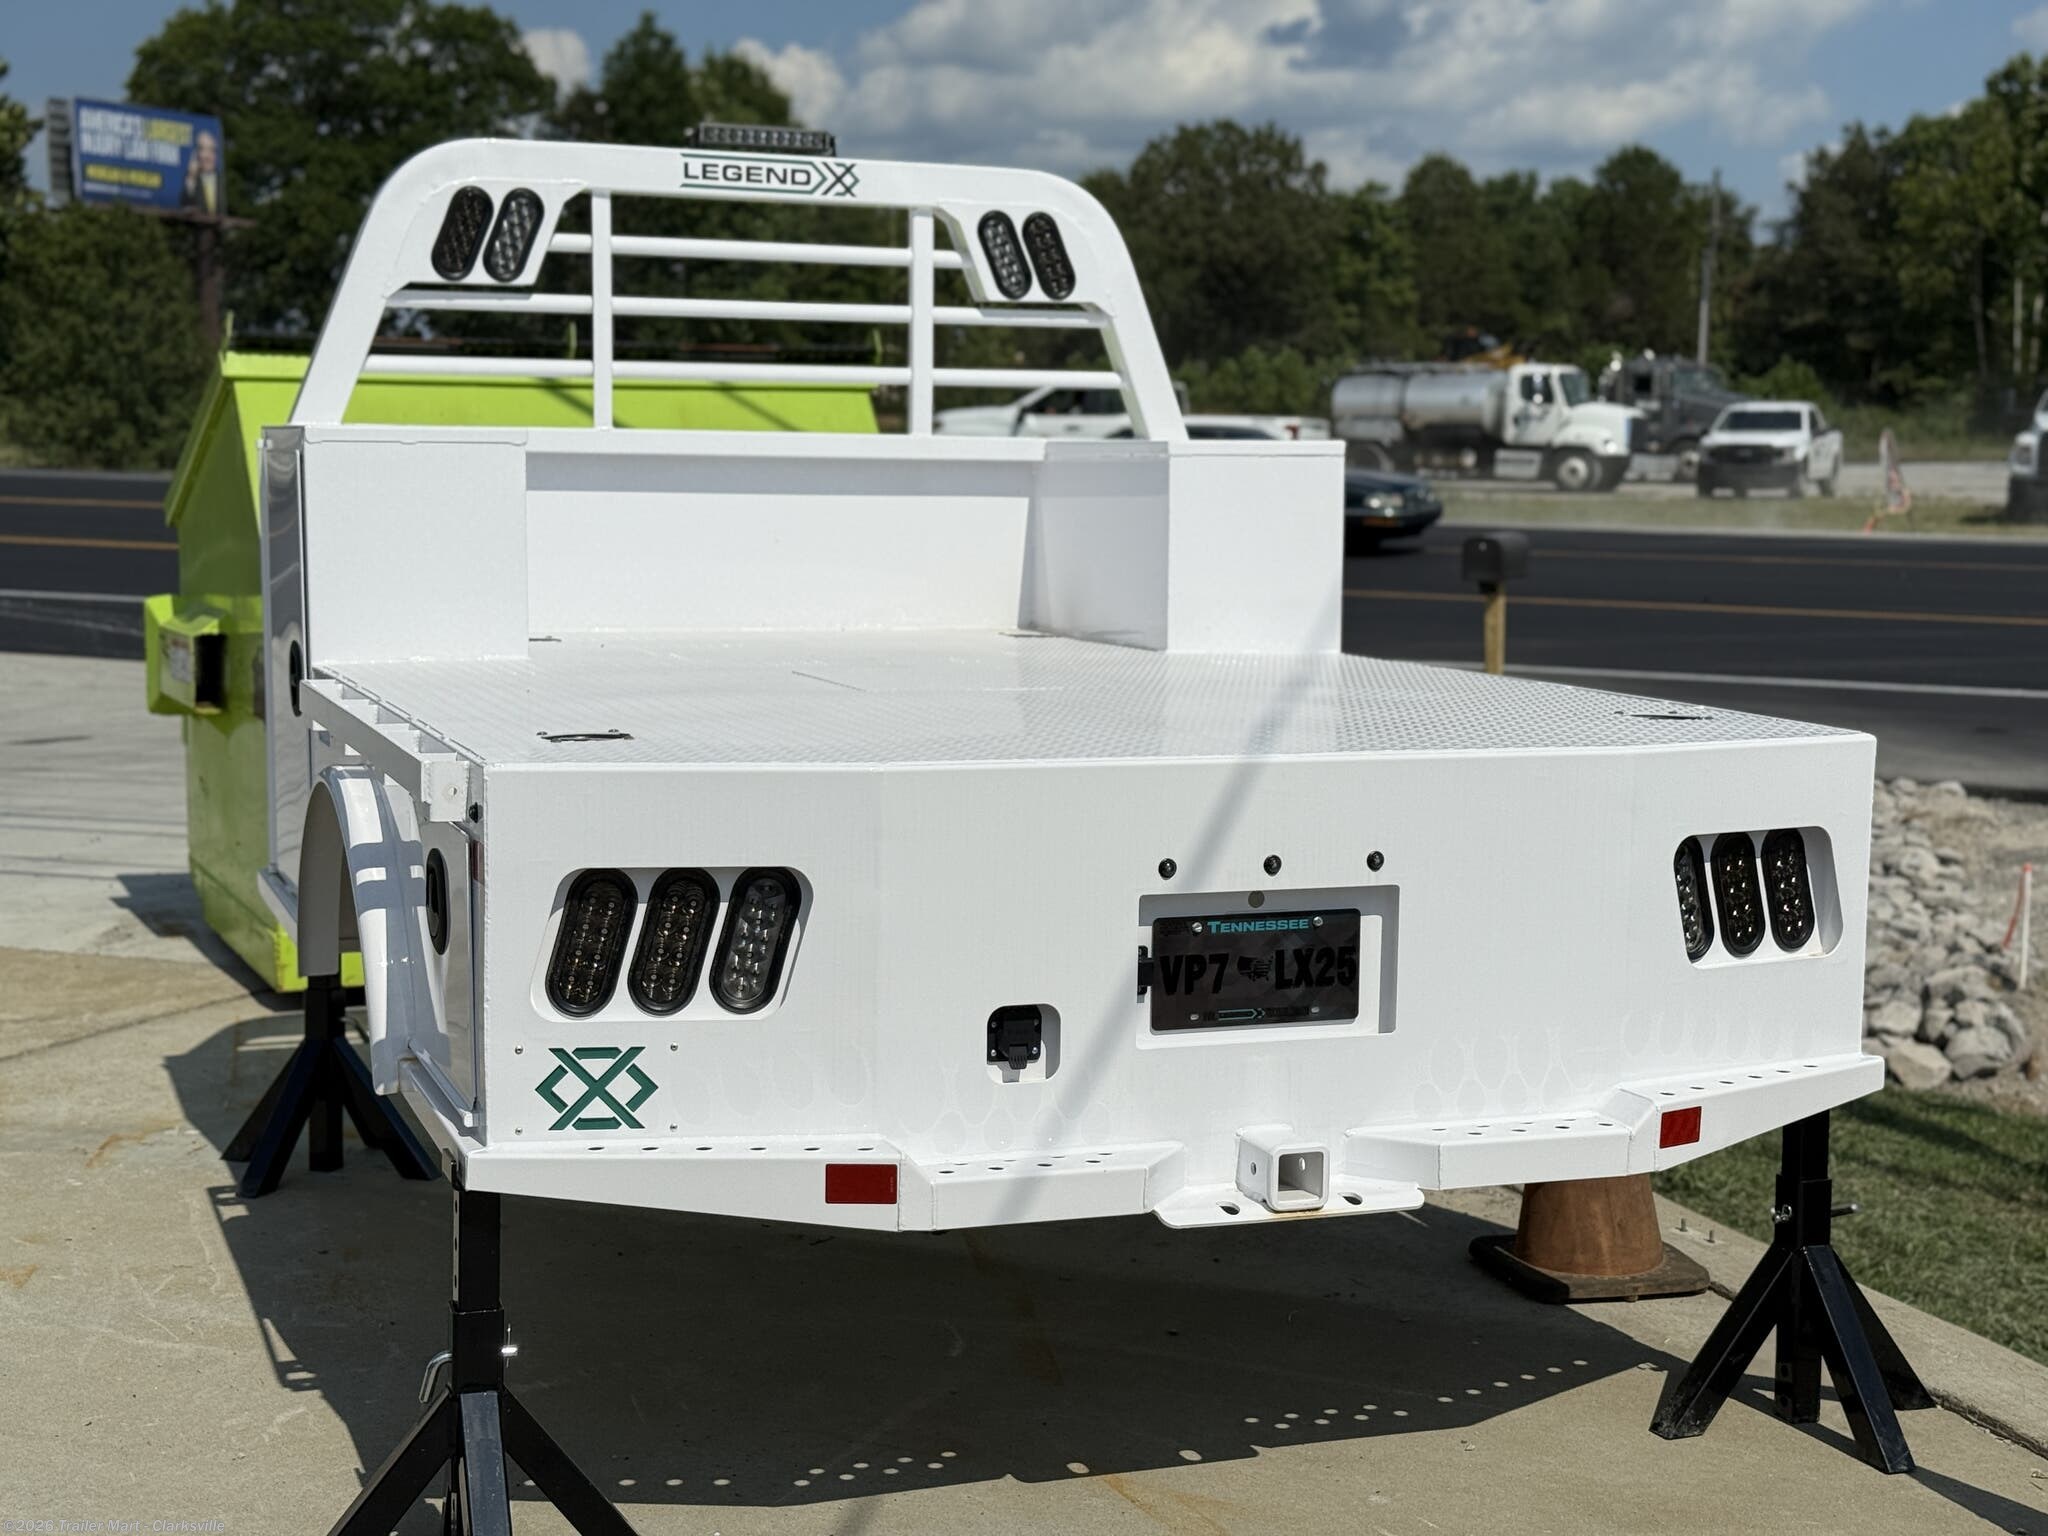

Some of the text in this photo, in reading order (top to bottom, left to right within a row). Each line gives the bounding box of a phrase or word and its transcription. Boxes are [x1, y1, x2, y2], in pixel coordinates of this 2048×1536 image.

[683, 161, 812, 187] LEGEND
[1159, 945, 1357, 996] VP7 LX25
